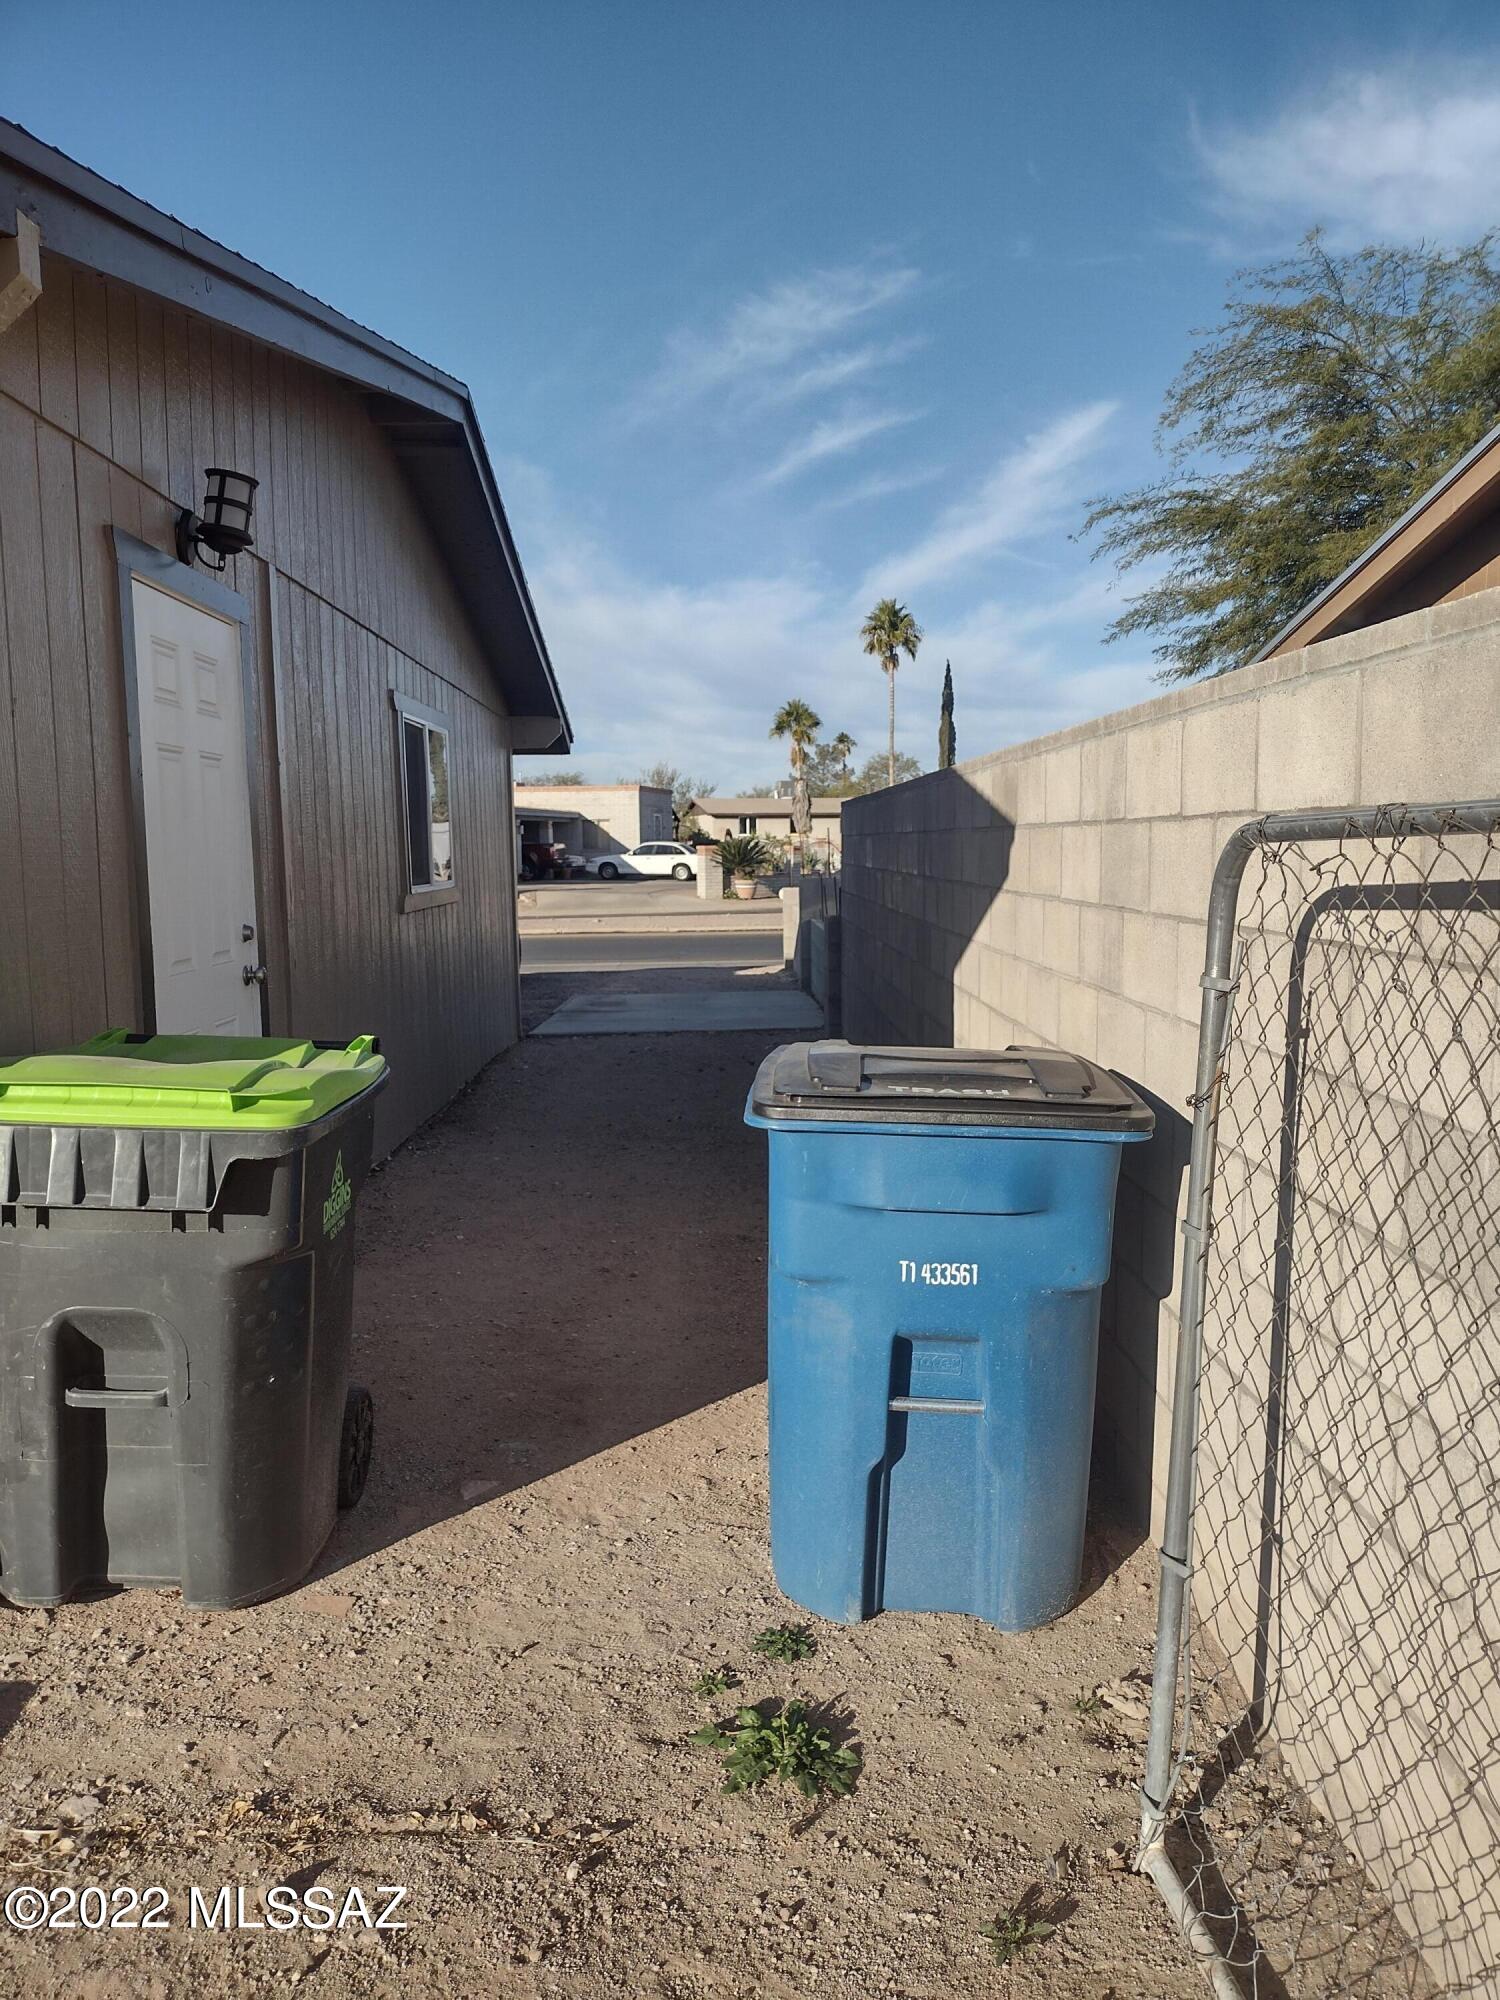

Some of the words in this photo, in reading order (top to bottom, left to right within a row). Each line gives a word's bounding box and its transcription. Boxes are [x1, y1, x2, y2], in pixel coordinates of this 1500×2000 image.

[888, 1085, 1010, 1096] TRASH
[323, 1179, 351, 1224] DIGGINS
[899, 1260, 916, 1282] T1
[921, 1263, 978, 1286] 433561
